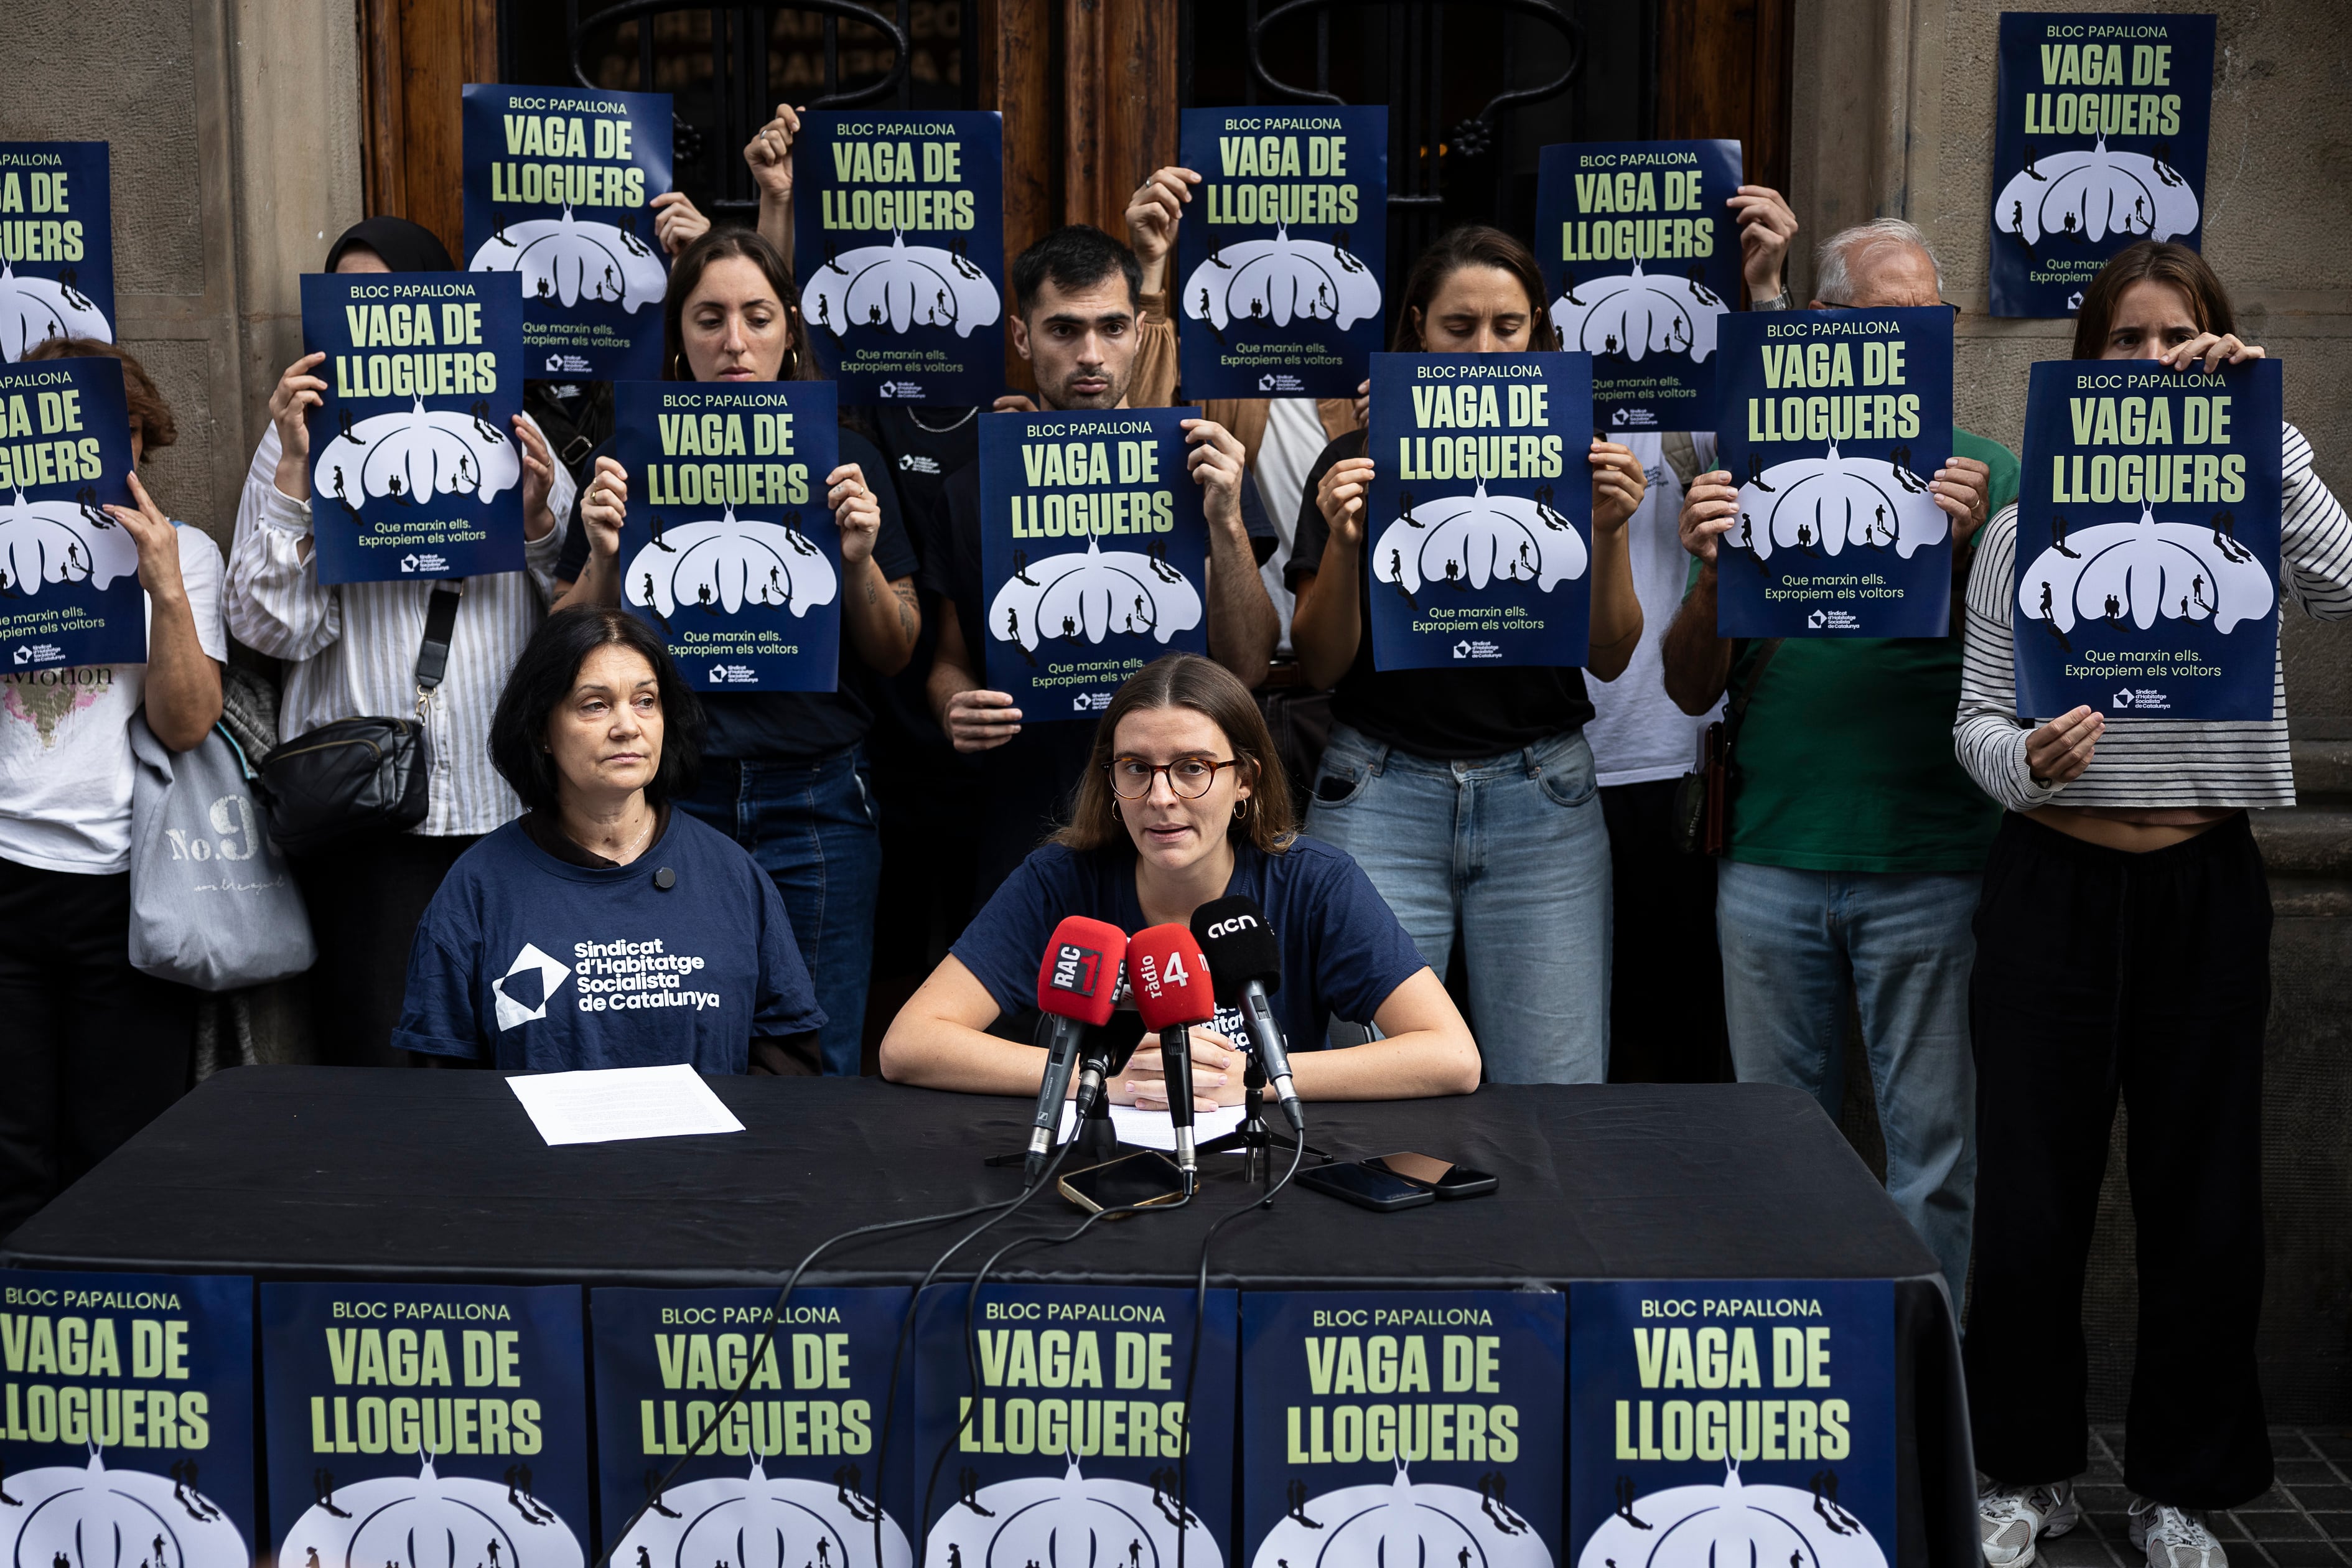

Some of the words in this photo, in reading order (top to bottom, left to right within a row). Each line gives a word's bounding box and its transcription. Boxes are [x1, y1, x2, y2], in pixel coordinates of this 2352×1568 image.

[2047, 26, 2083, 37] BLOC
[2089, 26, 2167, 38] PAPALLONA
[2041, 45, 2123, 85] VAGA
[2132, 45, 2171, 85] DE
[510, 97, 545, 109] BLOC
[550, 99, 626, 113] PAPALLONA
[1226, 118, 1260, 130] BLOC
[1265, 118, 1341, 129] PAPALLONA
[2025, 93, 2180, 135] LLOGUERS
[504, 114, 586, 157] VAGA
[595, 119, 632, 159] DE
[838, 124, 872, 136] BLOC
[878, 124, 954, 135] PAPALLONA
[833, 142, 915, 182] VAGA
[923, 143, 961, 182] DE
[1220, 137, 1300, 176] VAGA
[1309, 137, 1345, 175] DE
[1580, 155, 1615, 167] BLOC
[1620, 152, 1697, 165] PAPALLONA
[31, 173, 68, 212] DE
[492, 162, 644, 207] LLOGUERS
[1575, 172, 1656, 213] VAGA
[1665, 171, 1701, 210] DE
[823, 190, 974, 230] LLOGUERS
[1208, 185, 1358, 223] LLOGUERS
[1563, 218, 1713, 261] LLOGUERS
[351, 286, 388, 298] BLOC
[394, 284, 475, 296] PAPALLONA
[346, 304, 435, 347] VAGA
[442, 304, 482, 344] DE
[1768, 324, 1806, 337] BLOC
[1813, 322, 1899, 335] PAPALLONA
[337, 352, 496, 398] LLOGUERS
[1418, 366, 1455, 378] BLOC
[1461, 366, 1541, 377] PAPALLONA
[1762, 343, 1854, 388] VAGA
[1864, 342, 1905, 385] DE
[2078, 375, 2121, 388] BLOC
[2128, 374, 2226, 388] PAPALLONA
[38, 390, 83, 434] DE
[663, 394, 700, 407] BLOC
[706, 394, 786, 406] PAPALLONA
[1412, 385, 1500, 428] VAGA
[1509, 385, 1548, 426] DE
[1748, 394, 1919, 441] LLOGUERS
[658, 414, 746, 455] VAGA
[754, 414, 793, 455] DE
[1027, 424, 1065, 437] BLOC
[1070, 422, 1152, 434] PAPALLONA
[2070, 397, 2172, 445] VAGA
[2184, 396, 2231, 444] DE
[1022, 442, 1111, 487] VAGA
[1119, 441, 1159, 483] DE
[1400, 436, 1562, 480] LLOGUERS
[648, 464, 808, 504] LLOGUERS
[2053, 455, 2245, 503] LLOGUERS
[375, 522, 401, 533] Que
[404, 521, 447, 531] marxin
[1011, 491, 1173, 538] LLOGUERS
[358, 535, 424, 548] Expropiem
[427, 533, 444, 543] els
[448, 531, 486, 542] voltors
[1765, 588, 1834, 602] Expropiem
[1837, 589, 1855, 599] els
[1859, 588, 1904, 598] voltors
[1782, 575, 1809, 587] Que
[1812, 574, 1857, 586] marxin
[1861, 574, 1886, 585] ells.
[1412, 621, 1478, 633] Expropiem
[1482, 620, 1498, 630] els
[1503, 619, 1544, 629] voltors
[1429, 607, 1455, 618] Que
[1458, 607, 1501, 617] marxin
[1505, 607, 1526, 617] ells.
[684, 632, 709, 643] Que
[713, 632, 755, 641] marxin
[736, 644, 754, 654] els
[757, 645, 798, 654] voltors
[2085, 650, 2116, 663] Que
[2120, 650, 2170, 661] marxin
[2174, 650, 2202, 661] ells.
[1032, 675, 1097, 688] Expropiem
[1100, 673, 1117, 681] els
[1048, 664, 1073, 674] Que
[1076, 660, 1120, 671] marxin
[2065, 665, 2142, 679] Expropiem
[2147, 665, 2167, 676] els
[2172, 665, 2221, 676] voltors
[1208, 914, 1258, 939] acn
[574, 938, 664, 958] Sindicat
[576, 954, 705, 975] d'Habitatge
[577, 972, 680, 994] Socialista
[1054, 946, 1081, 987] RAC
[1080, 953, 1099, 992] 1
[1163, 951, 1189, 987] 4
[578, 996, 607, 1012] de
[609, 989, 720, 1010] Catalunya
[6, 1287, 57, 1306] BLOC
[64, 1290, 180, 1310] PAPALLONA
[333, 1302, 386, 1318] BLOC
[394, 1303, 510, 1320] PAPALLONA
[662, 1308, 716, 1324] BLOC
[986, 1303, 1040, 1322] BLOC
[1048, 1304, 1165, 1322] PAPALLONA
[1642, 1300, 1696, 1317] BLOC
[1704, 1300, 1822, 1316] PAPALLONA
[1314, 1310, 1367, 1327] BLOC
[1375, 1309, 1492, 1325] PAPALLONA
[0, 1314, 123, 1376] VAGA
[133, 1320, 189, 1379] DE
[326, 1328, 451, 1386] VAGA
[463, 1330, 520, 1386] DE
[655, 1334, 781, 1390] VAGA
[793, 1334, 850, 1389] DE
[978, 1330, 1103, 1388] VAGA
[1116, 1332, 1172, 1389] DE
[1305, 1335, 1430, 1394] VAGA
[1444, 1336, 1499, 1393] DE
[1634, 1327, 1760, 1388] VAGA
[1773, 1327, 1830, 1387] DE
[0, 1384, 208, 1449] LOGUERS
[311, 1397, 541, 1454] LLOGUERS
[641, 1400, 871, 1455] LLOGUERS
[959, 1397, 1190, 1457] LLOGUERS
[1287, 1404, 1518, 1463] LLOGUERS
[1616, 1399, 1849, 1460] LLOGUERS
